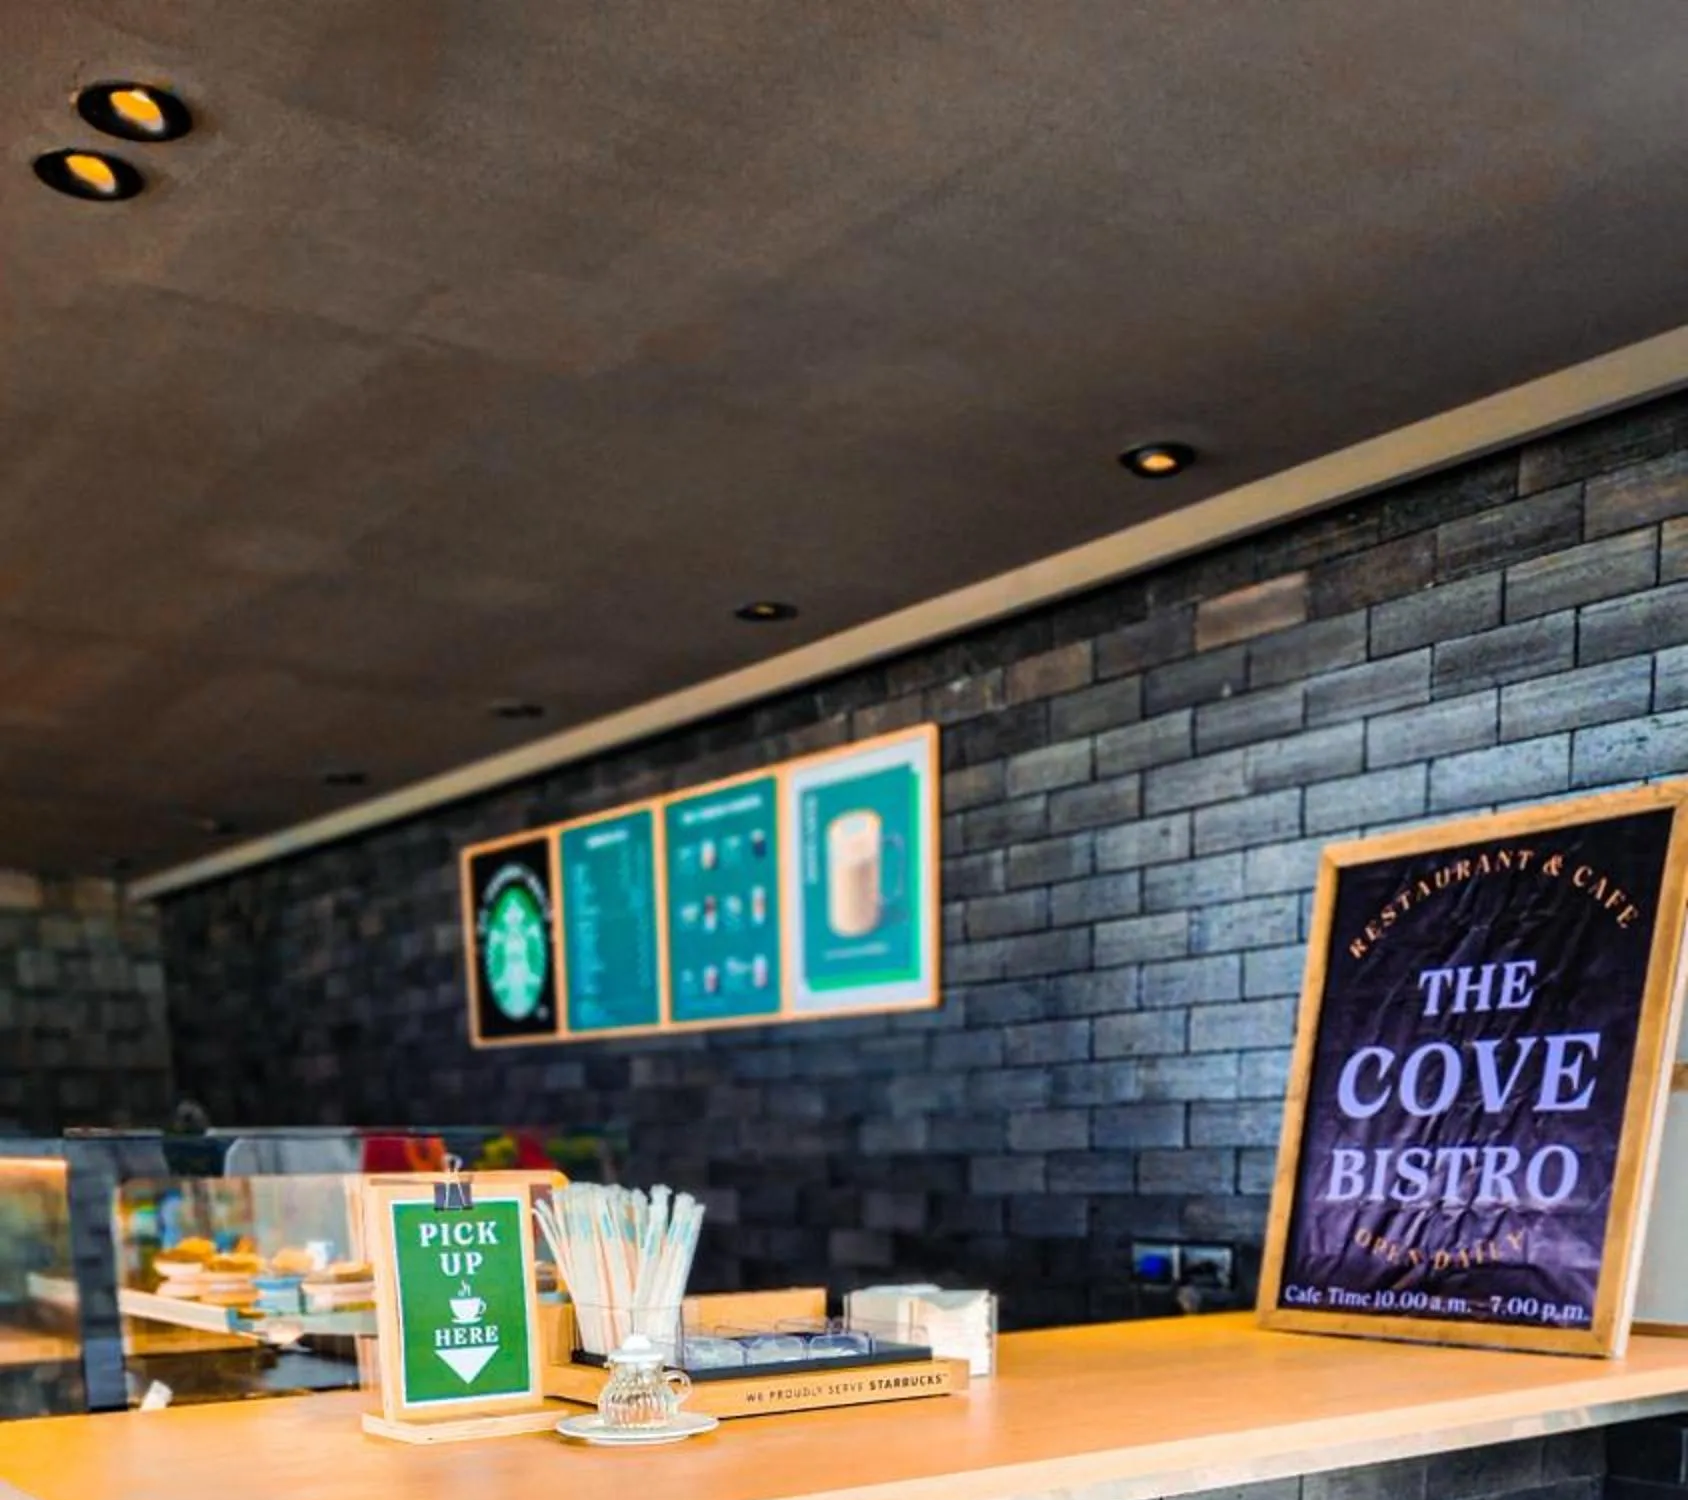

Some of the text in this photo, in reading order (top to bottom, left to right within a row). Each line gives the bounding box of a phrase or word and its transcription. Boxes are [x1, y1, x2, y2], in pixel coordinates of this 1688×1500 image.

[1349, 850, 1639, 959] RESTAURANT & CAFE
[1418, 960, 1537, 1016] THE
[1337, 1031, 1600, 1120] COVE
[1325, 1144, 1579, 1205] BISTRO
[418, 1221, 499, 1247] PICK
[1354, 1228, 1525, 1271] OPEN DAILY
[439, 1251, 483, 1276] UP
[1327, 1287, 1370, 1307] Time
[1374, 1290, 1428, 1309] 10.00
[1490, 1295, 1539, 1316] 7.00
[434, 1325, 499, 1346] HERE
[746, 1374, 943, 1402] WE PROUDLY SERVE STARBUCKS
